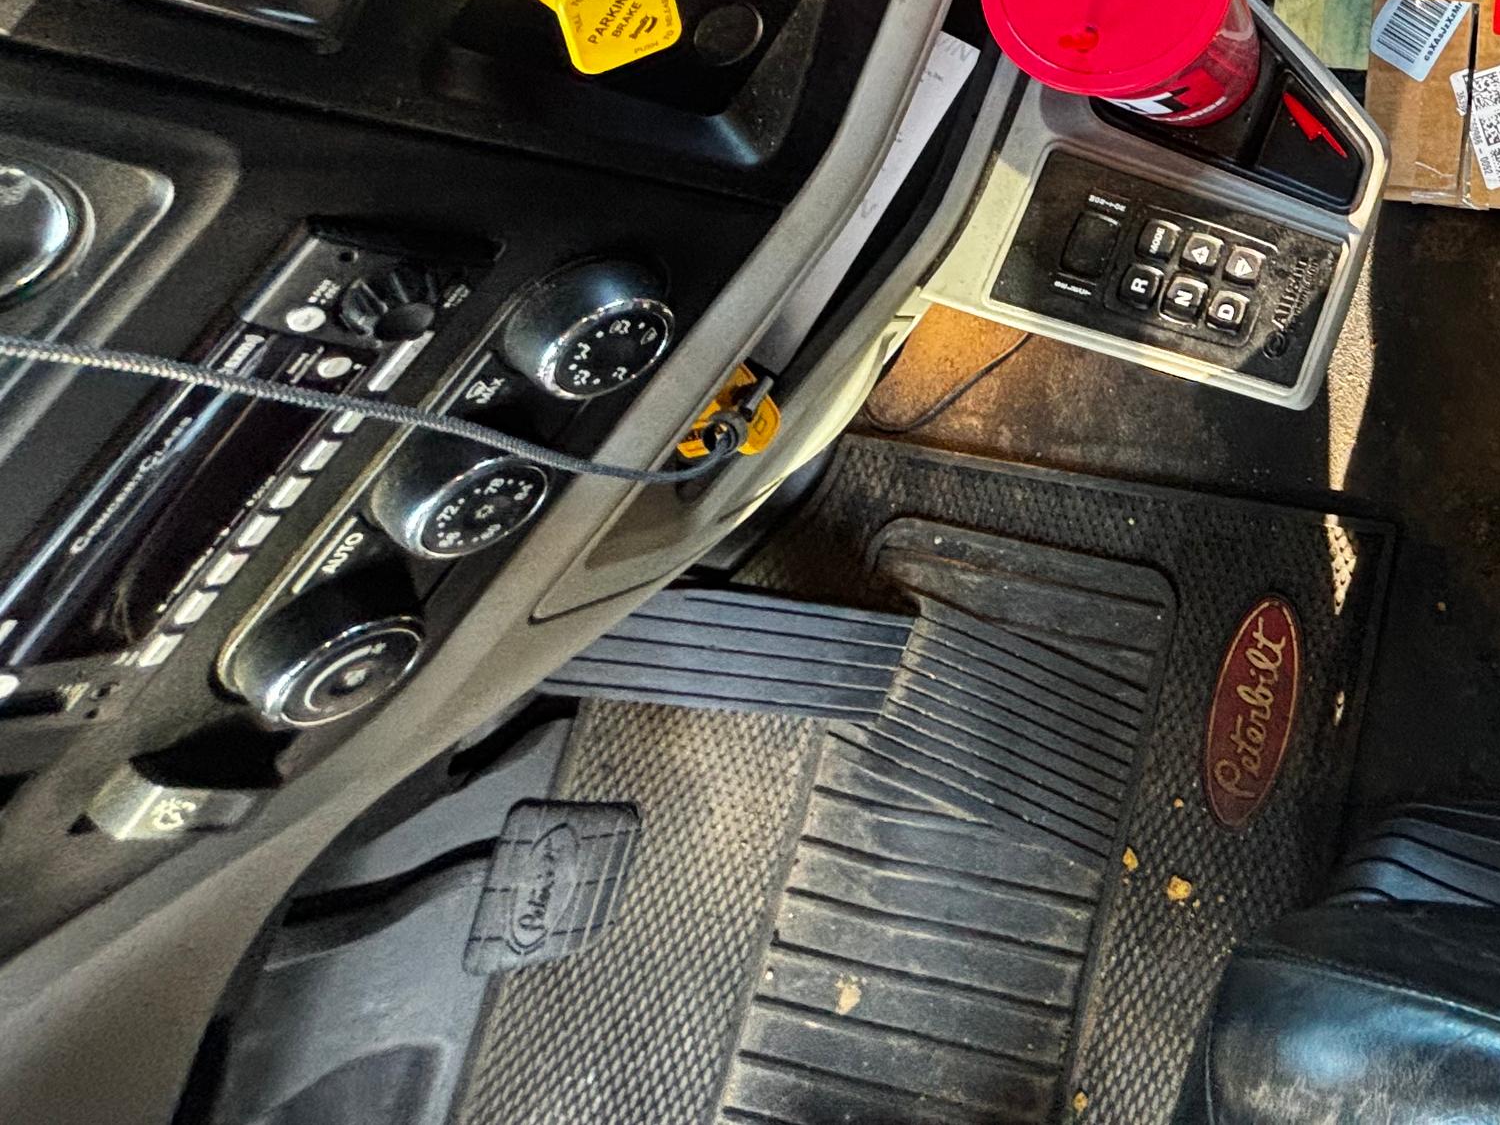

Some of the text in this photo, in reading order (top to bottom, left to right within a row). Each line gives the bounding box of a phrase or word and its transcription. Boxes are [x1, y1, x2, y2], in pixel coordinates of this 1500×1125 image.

[611, 1, 643, 38] BRAKE
[1148, 226, 1166, 255] MODE
[1130, 277, 1236, 322] R N D
[435, 504, 460, 523] 72
[321, 531, 364, 575] AUTO
[1213, 615, 1287, 798] Peterbilt
